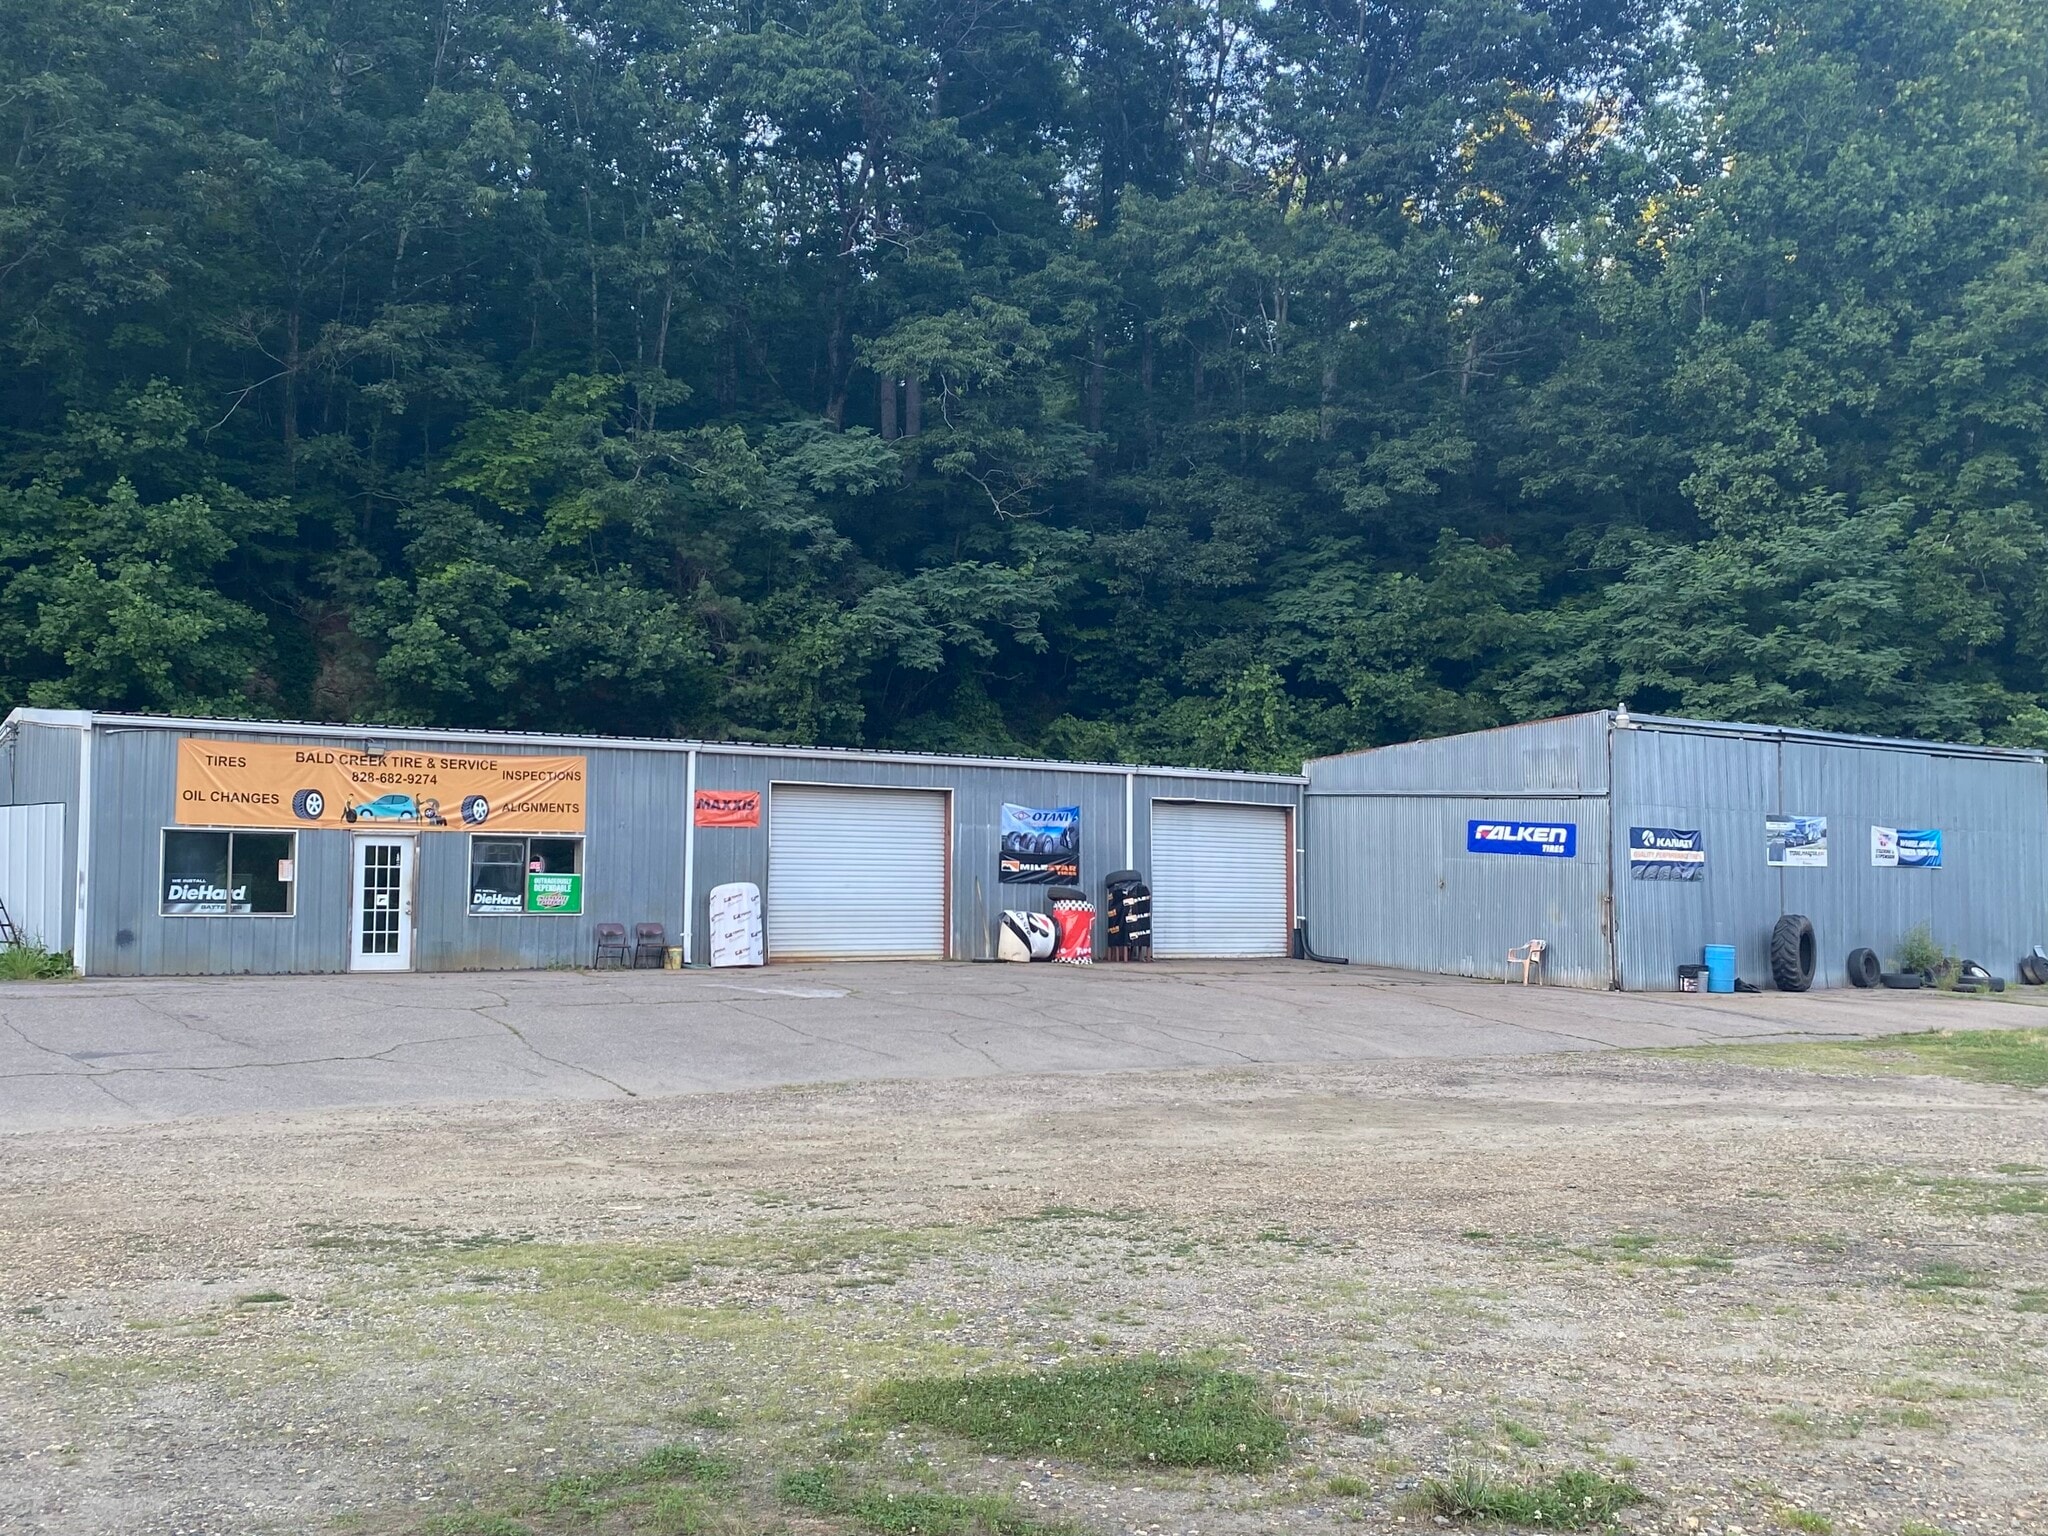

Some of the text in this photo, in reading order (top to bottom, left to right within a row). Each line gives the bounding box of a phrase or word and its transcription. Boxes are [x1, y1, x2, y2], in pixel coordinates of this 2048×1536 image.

[206, 755, 246, 767] TIRES
[296, 751, 498, 771] BALD CREEK TIRE & SERVICE
[352, 771, 437, 785] 828-682-9274
[502, 770, 581, 782] INSPECTIONS
[182, 789, 279, 804] OIL CHANGES
[502, 802, 580, 814] ALIGNMENTS
[696, 798, 755, 811] MAXXIS
[1032, 812, 1069, 822] OTANI
[1475, 825, 1567, 843] FALKEN
[1542, 844, 1565, 853] TIRES
[1020, 863, 1077, 872] MILESTAR
[168, 884, 246, 901] DieHad
[473, 893, 521, 905] DieHard
